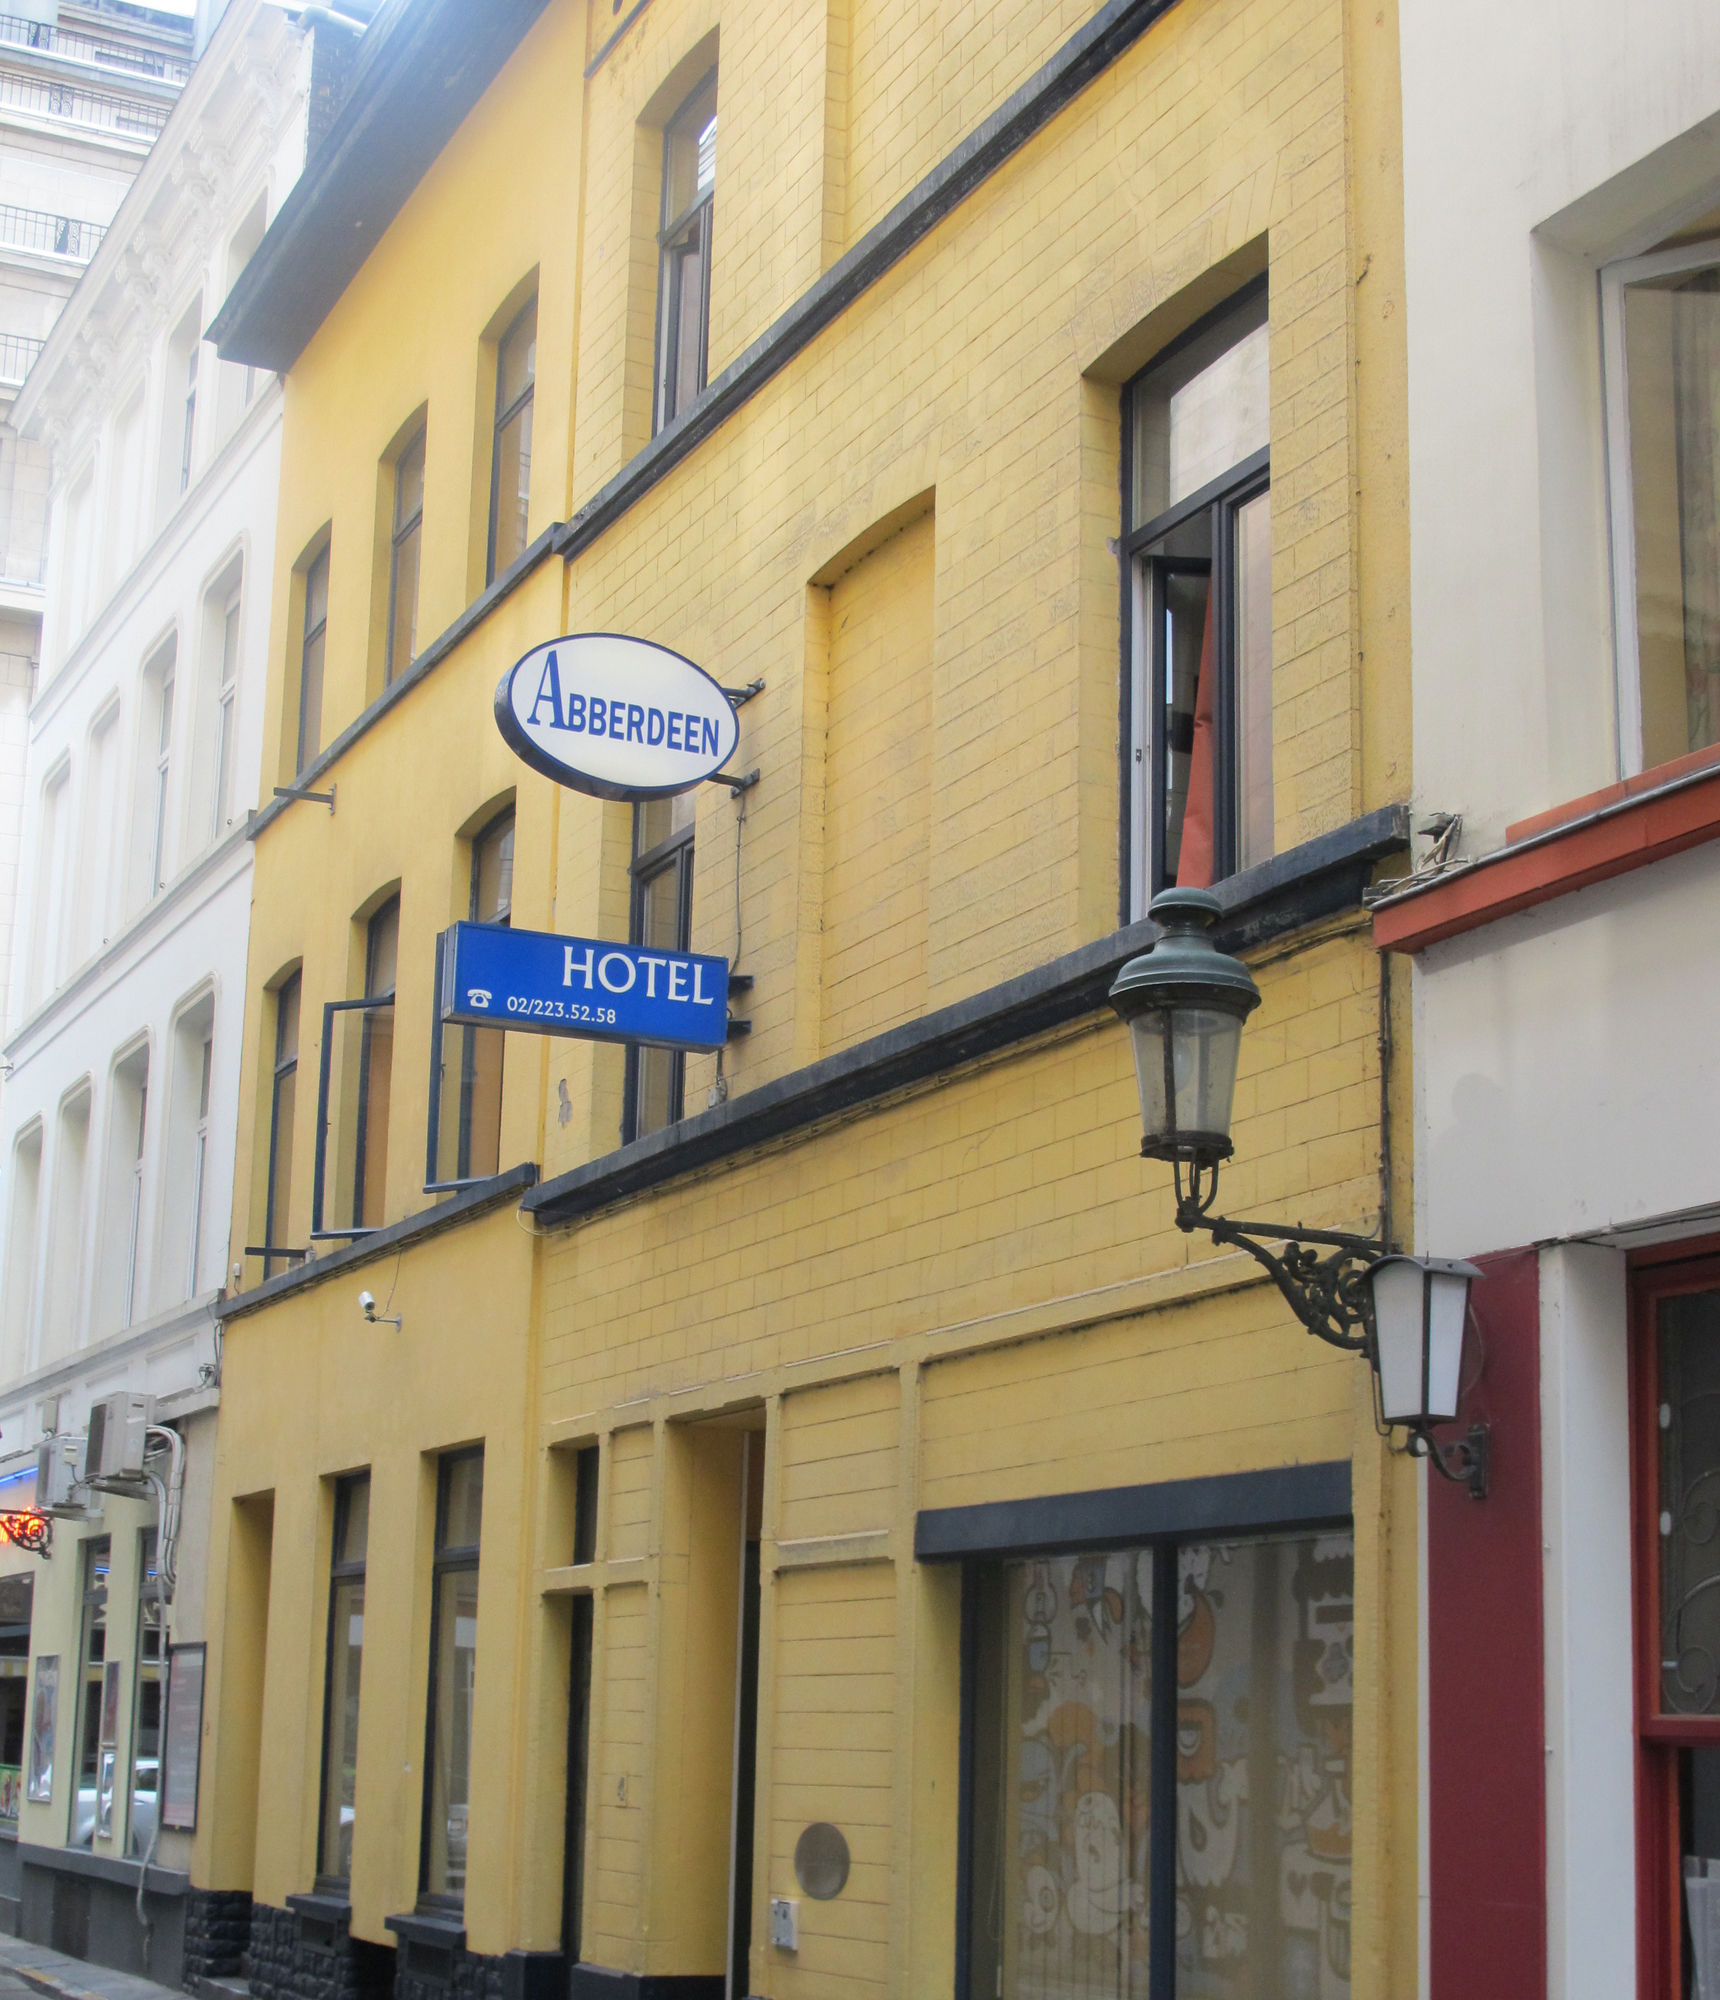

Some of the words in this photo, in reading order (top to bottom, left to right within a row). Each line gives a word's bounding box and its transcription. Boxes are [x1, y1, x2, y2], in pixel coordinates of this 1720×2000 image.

[527, 650, 719, 757] ABBERDEEN
[562, 945, 714, 1005] HOTEL
[506, 996, 616, 1025] 02/223.52.58
